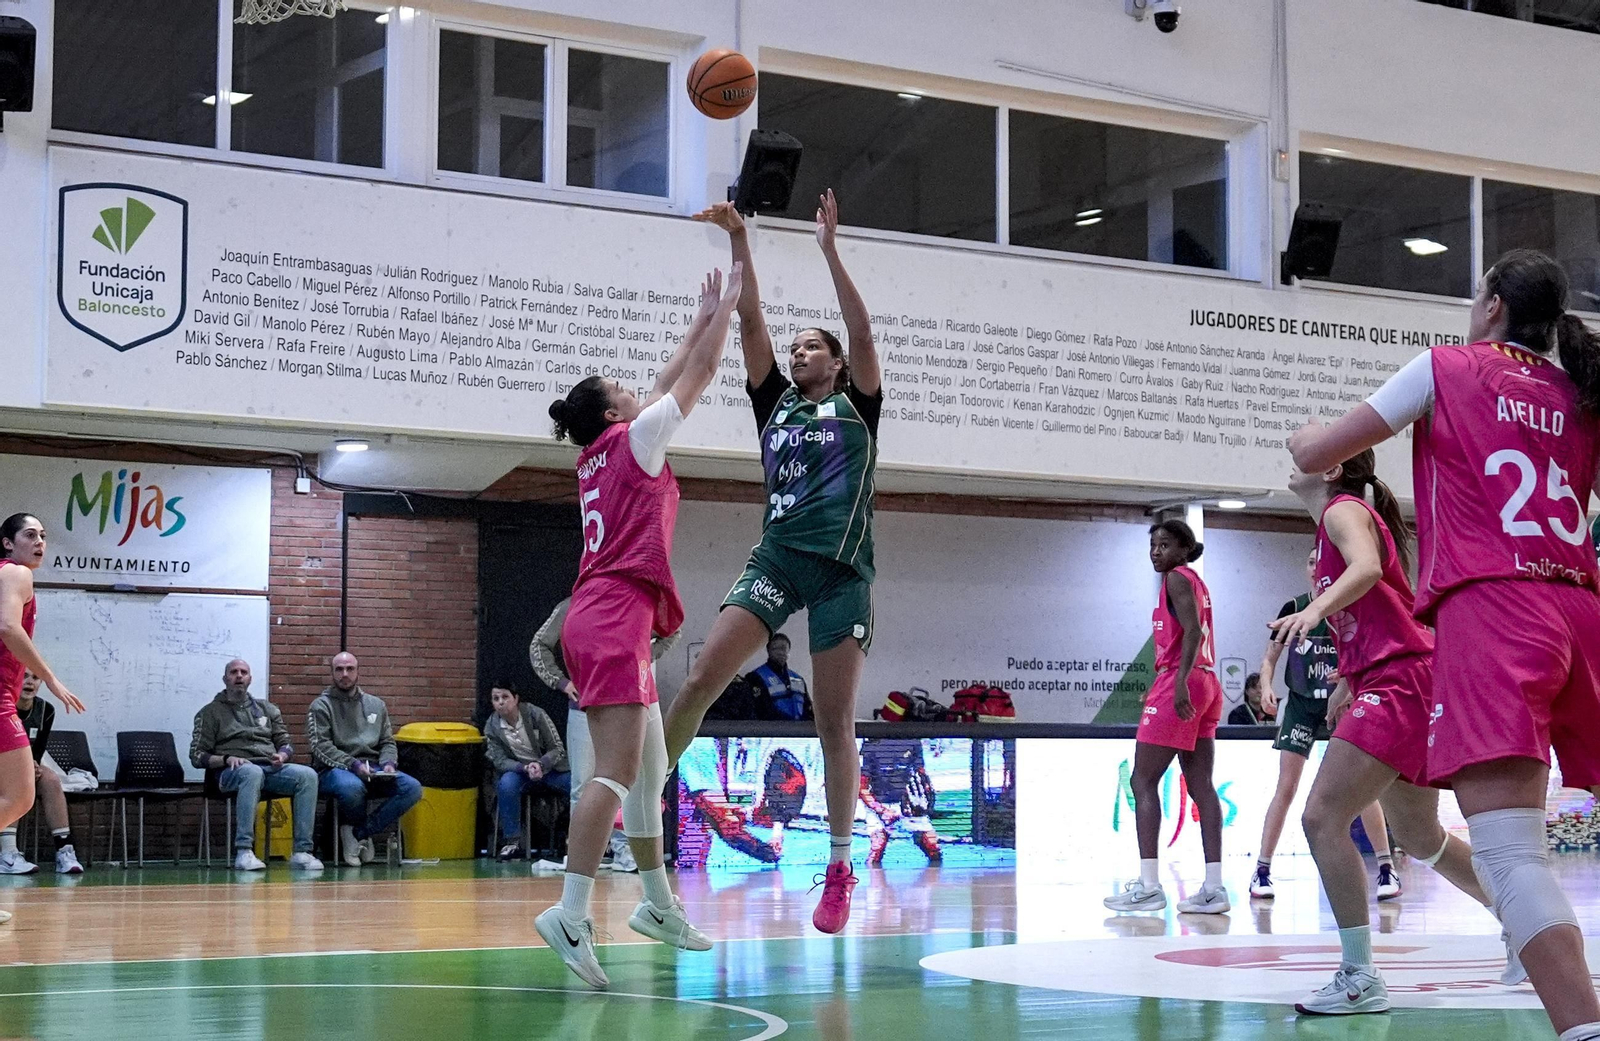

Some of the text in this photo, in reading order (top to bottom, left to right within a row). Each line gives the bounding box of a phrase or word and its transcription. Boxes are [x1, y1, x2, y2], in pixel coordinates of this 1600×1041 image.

[79, 260, 166, 282] Fundación
[78, 298, 166, 318] Baloncesto
[92, 282, 154, 304] Unicaja
[219, 247, 269, 267] Joaquín
[273, 252, 372, 277] Entrambasaguas
[382, 263, 416, 280] Julián
[488, 273, 529, 291] Manolo
[532, 277, 564, 295] Rubia
[572, 282, 604, 298] Salva
[606, 285, 638, 302] Gallar
[648, 289, 696, 307] Bernardo
[786, 303, 822, 319] Ramos
[901, 314, 938, 330] Caneda
[945, 318, 981, 334] Ricardo
[983, 322, 1018, 338] Galeote
[1026, 326, 1053, 343] Diego
[1054, 329, 1086, 344] Gómez
[1094, 333, 1115, 347] Rafa
[1116, 335, 1138, 349] Pozo
[1144, 339, 1165, 352] José
[1166, 340, 1198, 355] Antonio
[1200, 343, 1236, 358] Sánchez
[1236, 346, 1266, 361] Aranda
[201, 288, 250, 307] Antonio
[252, 292, 300, 311] Benítez
[310, 298, 338, 315] José
[341, 301, 390, 319] Torrubia
[400, 306, 438, 323] Rafael
[440, 310, 478, 327] Ibáñez
[488, 314, 515, 331] José
[518, 316, 534, 331] Mª
[536, 318, 558, 334] Mur
[567, 321, 615, 341] Cristóbal
[618, 326, 656, 343] Suarez
[886, 350, 924, 366] Antonio
[926, 353, 968, 370] Mendoza
[976, 358, 1006, 375] Sergio
[1008, 360, 1048, 377] Pequeño
[1056, 365, 1076, 379] Dani
[1078, 367, 1113, 383] Romero
[1119, 368, 1144, 385] Curro
[1181, 376, 1203, 392] Gaby
[211, 267, 243, 285] Paco
[246, 271, 292, 290] Cabello
[302, 276, 340, 295] Miguel
[344, 279, 378, 298] Pérez
[387, 285, 430, 302] Alfonso
[432, 289, 470, 306] Portillo
[480, 293, 518, 311] Patrick
[520, 297, 578, 316] Fernández
[587, 303, 618, 320] Pedro
[621, 305, 650, 323] Marín
[660, 311, 680, 325] J.C.
[882, 328, 910, 348] Ángel
[944, 337, 965, 352] Lara
[972, 340, 994, 354] José
[996, 341, 1025, 357] Carlos
[1027, 341, 1059, 362] Gaspar
[1066, 349, 1087, 363] José
[1088, 351, 1121, 366] Antonio
[1122, 354, 1155, 371] Villegas
[1162, 357, 1201, 373] Fernando
[1190, 308, 1275, 333] JUGADORES
[1280, 318, 1298, 335] DE
[1302, 320, 1366, 342] CANTERA
[1370, 327, 1398, 345] QUE
[1402, 330, 1430, 347] HAN
[184, 328, 210, 347] Miki
[214, 331, 264, 350] Servera
[276, 336, 306, 353] Rafa
[309, 339, 346, 357] Freire
[356, 344, 406, 363] Augusto
[409, 348, 438, 364] Lima
[448, 351, 482, 368] Pablo
[484, 354, 534, 372] Almazán
[545, 359, 582, 376] Carlos
[584, 363, 599, 378] de
[602, 364, 637, 380] Cobos
[888, 387, 921, 402] Conde
[930, 387, 958, 407] Dejan
[1013, 397, 1043, 412] Kenan
[1103, 405, 1136, 421] Ognjen
[193, 308, 230, 326] David
[233, 311, 250, 328] Gil
[262, 314, 306, 333] Manolo
[310, 318, 346, 336] Pérez
[356, 323, 395, 340] Rubén
[398, 326, 431, 346] Mayo
[440, 330, 494, 349] Alejandro
[496, 335, 521, 351] Alba
[531, 338, 575, 355] Germán
[578, 342, 618, 359] Gabriel
[627, 346, 657, 362] Manu
[884, 368, 919, 384] Francis
[921, 371, 952, 389] Perujo
[960, 375, 978, 388] Jon
[1038, 381, 1060, 395] Fran
[1062, 384, 1100, 400] Vázquez
[1107, 387, 1139, 402] Marcos
[175, 349, 212, 367] Pablo
[214, 352, 268, 371] Sánchez
[278, 358, 323, 379] Morgan
[326, 361, 363, 379] Stilma
[373, 365, 407, 382] Lucas
[410, 368, 448, 385] Muñoz
[457, 372, 494, 388] Rubén
[496, 375, 546, 393] Guerrero
[971, 413, 1000, 428] Rubén
[1002, 416, 1035, 430] Vicente
[1084, 422, 1097, 435] del
[1098, 424, 1117, 437] Pino
[1497, 396, 1564, 437] AIELLO
[66, 468, 186, 546] Mijas
[1484, 448, 1588, 546] 25
[54, 556, 190, 574] AYUNTAMIENTO
[750, 594, 774, 612] DENTAL
[1007, 657, 1044, 670] Puedo
[1092, 659, 1102, 671] el
[942, 678, 968, 692] pero
[1028, 679, 1070, 694] aceptar
[1074, 681, 1088, 692] no
